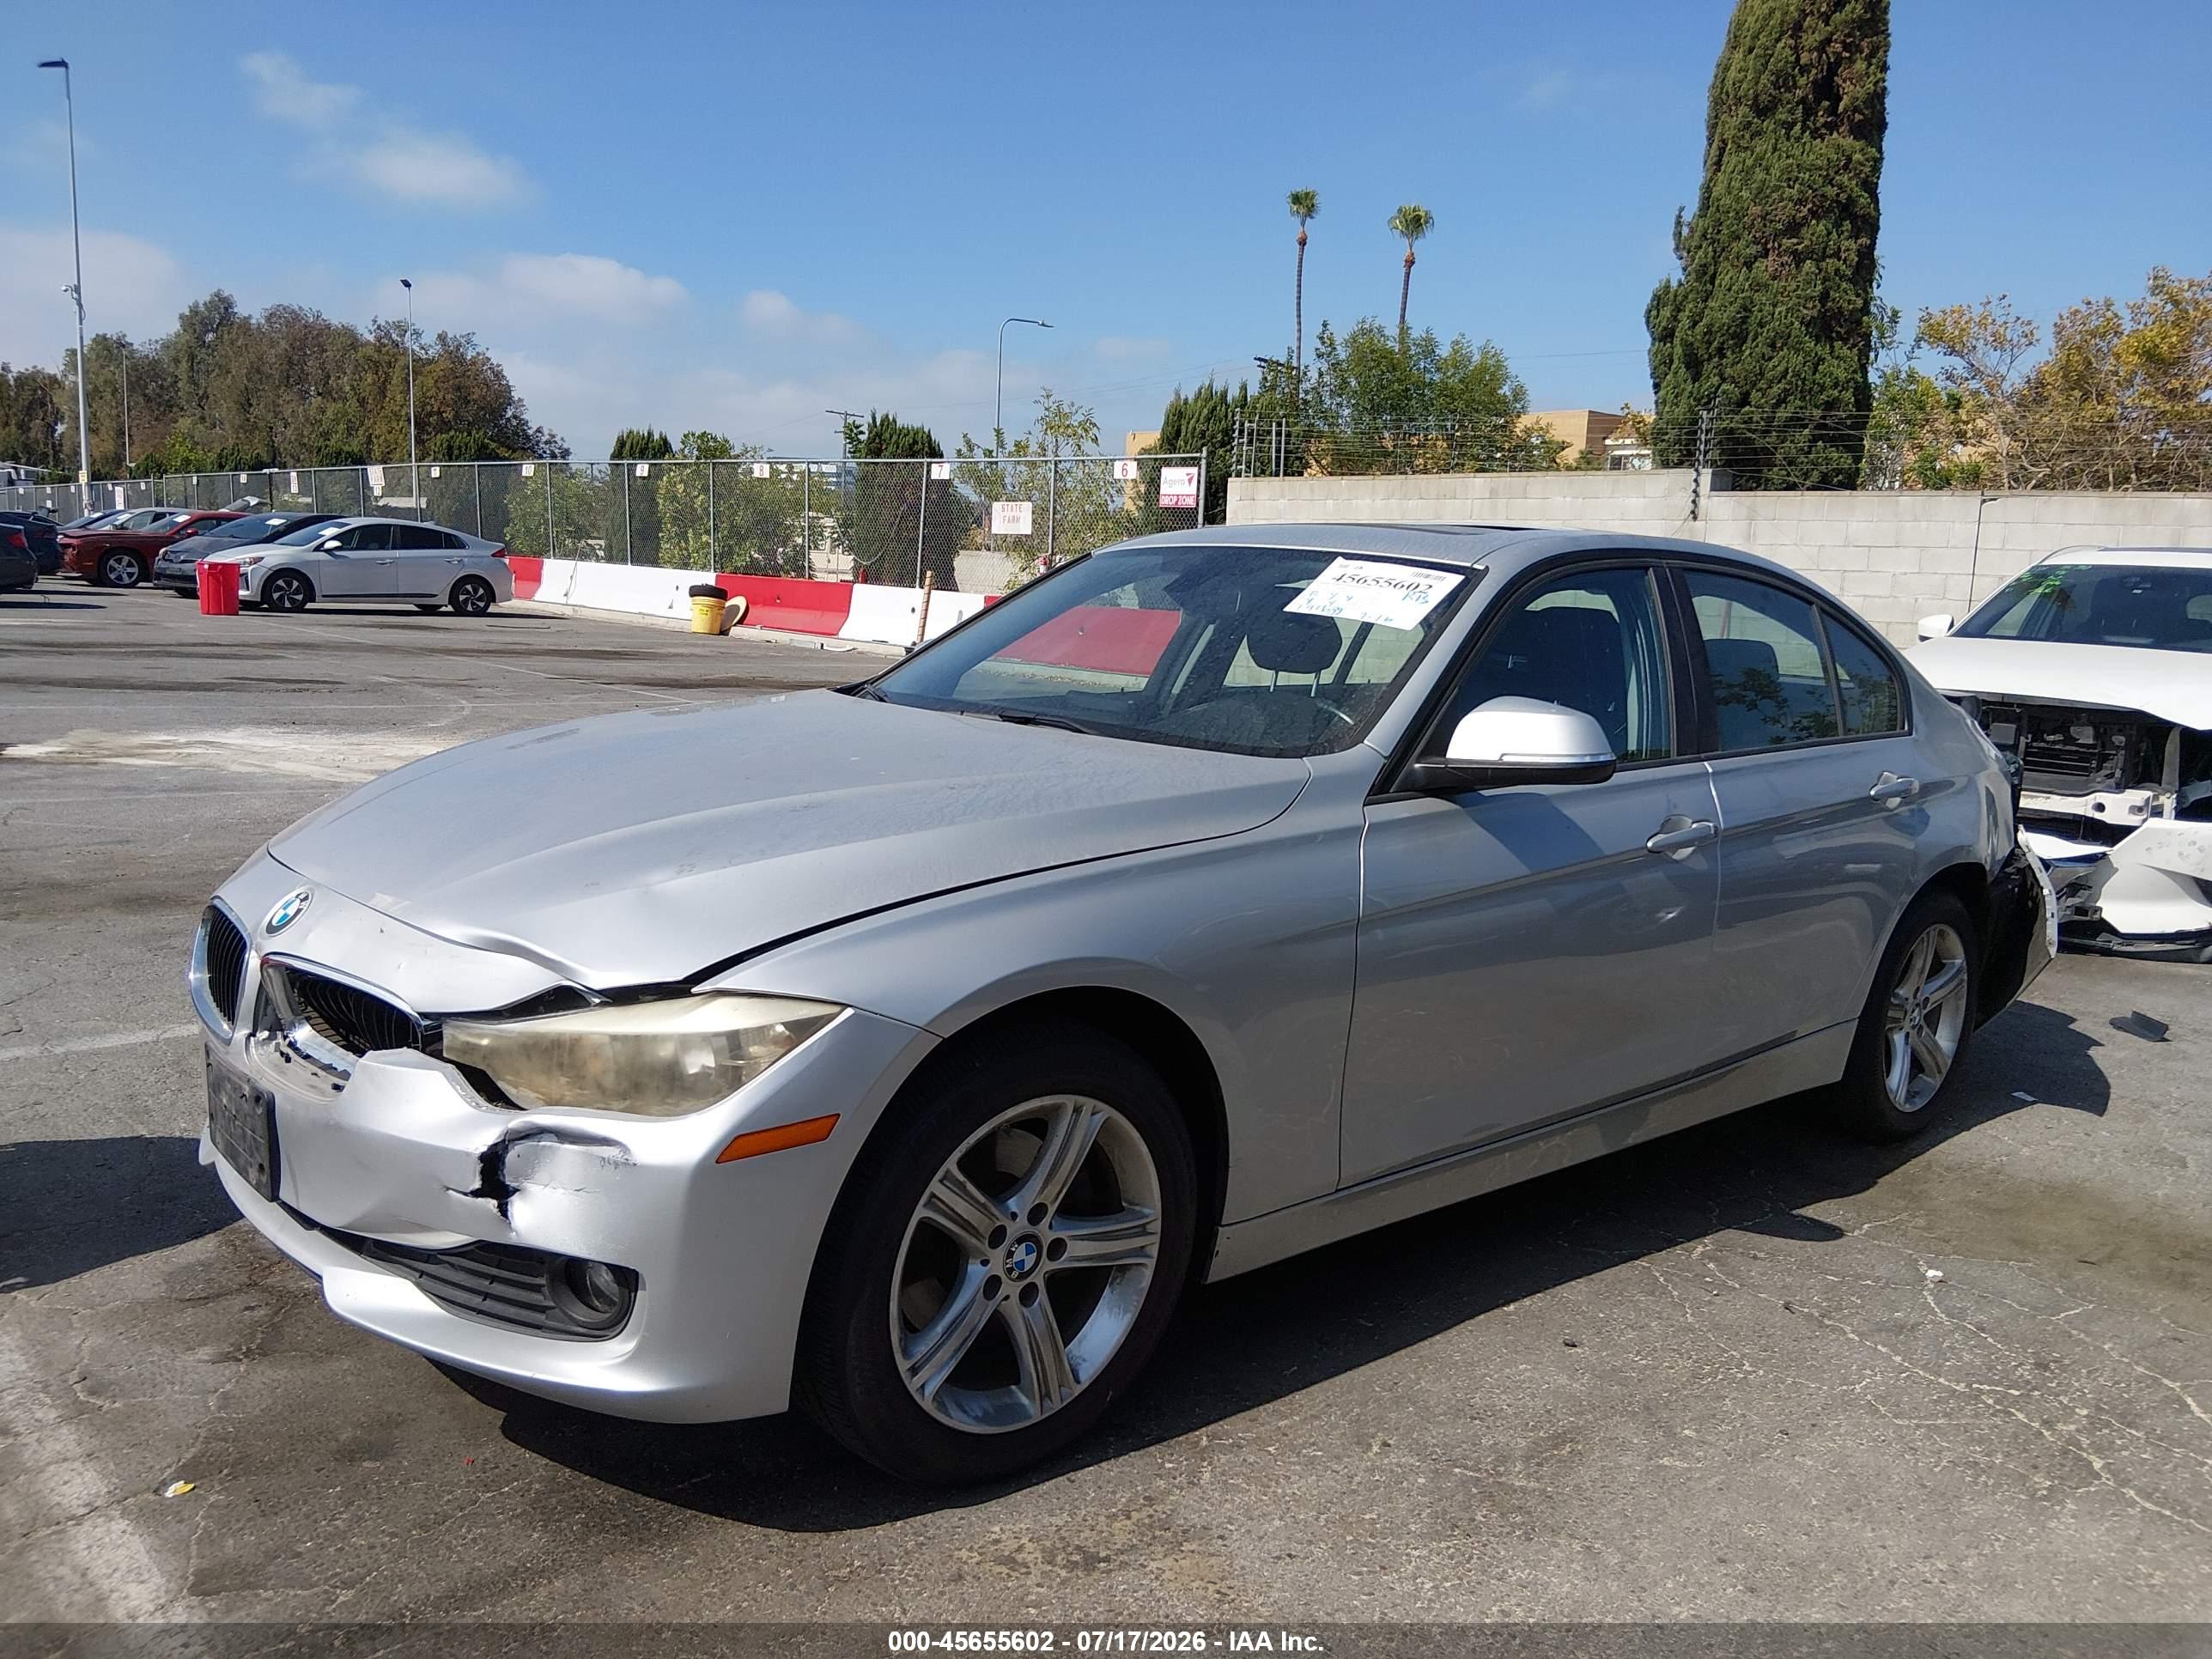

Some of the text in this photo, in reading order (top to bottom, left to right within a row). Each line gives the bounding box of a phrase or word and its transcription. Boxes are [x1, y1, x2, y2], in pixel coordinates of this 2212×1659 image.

[525, 465, 532, 476] 10
[759, 465, 764, 477] 8
[937, 465, 945, 477] 7
[1121, 463, 1128, 477] 6
[1162, 476, 1186, 489] Agero
[1161, 495, 1195, 506] DROP ZONE
[1001, 503, 1024, 513] STATE
[1002, 514, 1021, 524] FARM
[1332, 573, 1433, 593] 45655602
[1006, 1242, 1019, 1279] BMW
